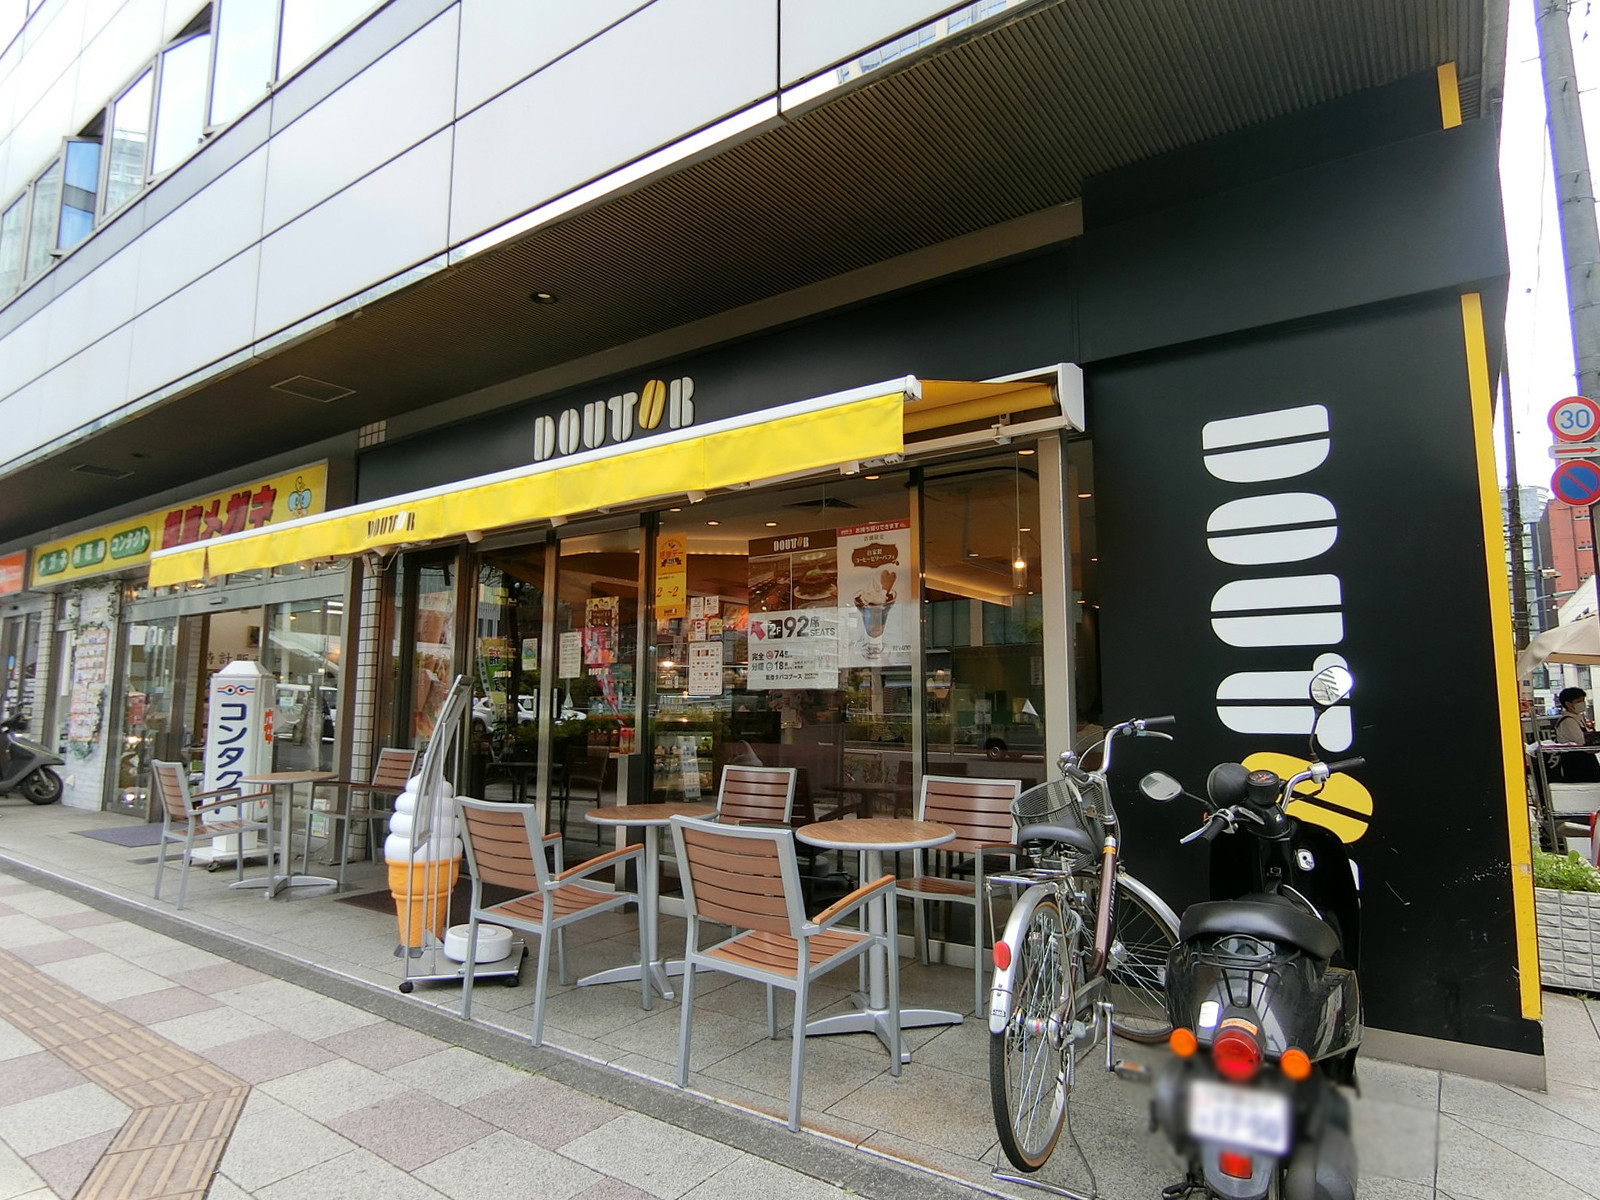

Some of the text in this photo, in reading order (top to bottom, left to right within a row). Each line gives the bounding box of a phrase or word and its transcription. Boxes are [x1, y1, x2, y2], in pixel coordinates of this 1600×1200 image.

[534, 376, 695, 462] DOUTOR
[1560, 409, 1590, 429] 30
[111, 527, 149, 552] コンタクト
[773, 537, 809, 551] DOUTOR
[768, 622, 782, 636] 2F
[783, 615, 809, 638] 92
[810, 628, 836, 637] SEATS
[1202, 403, 1375, 890] DOUTO
